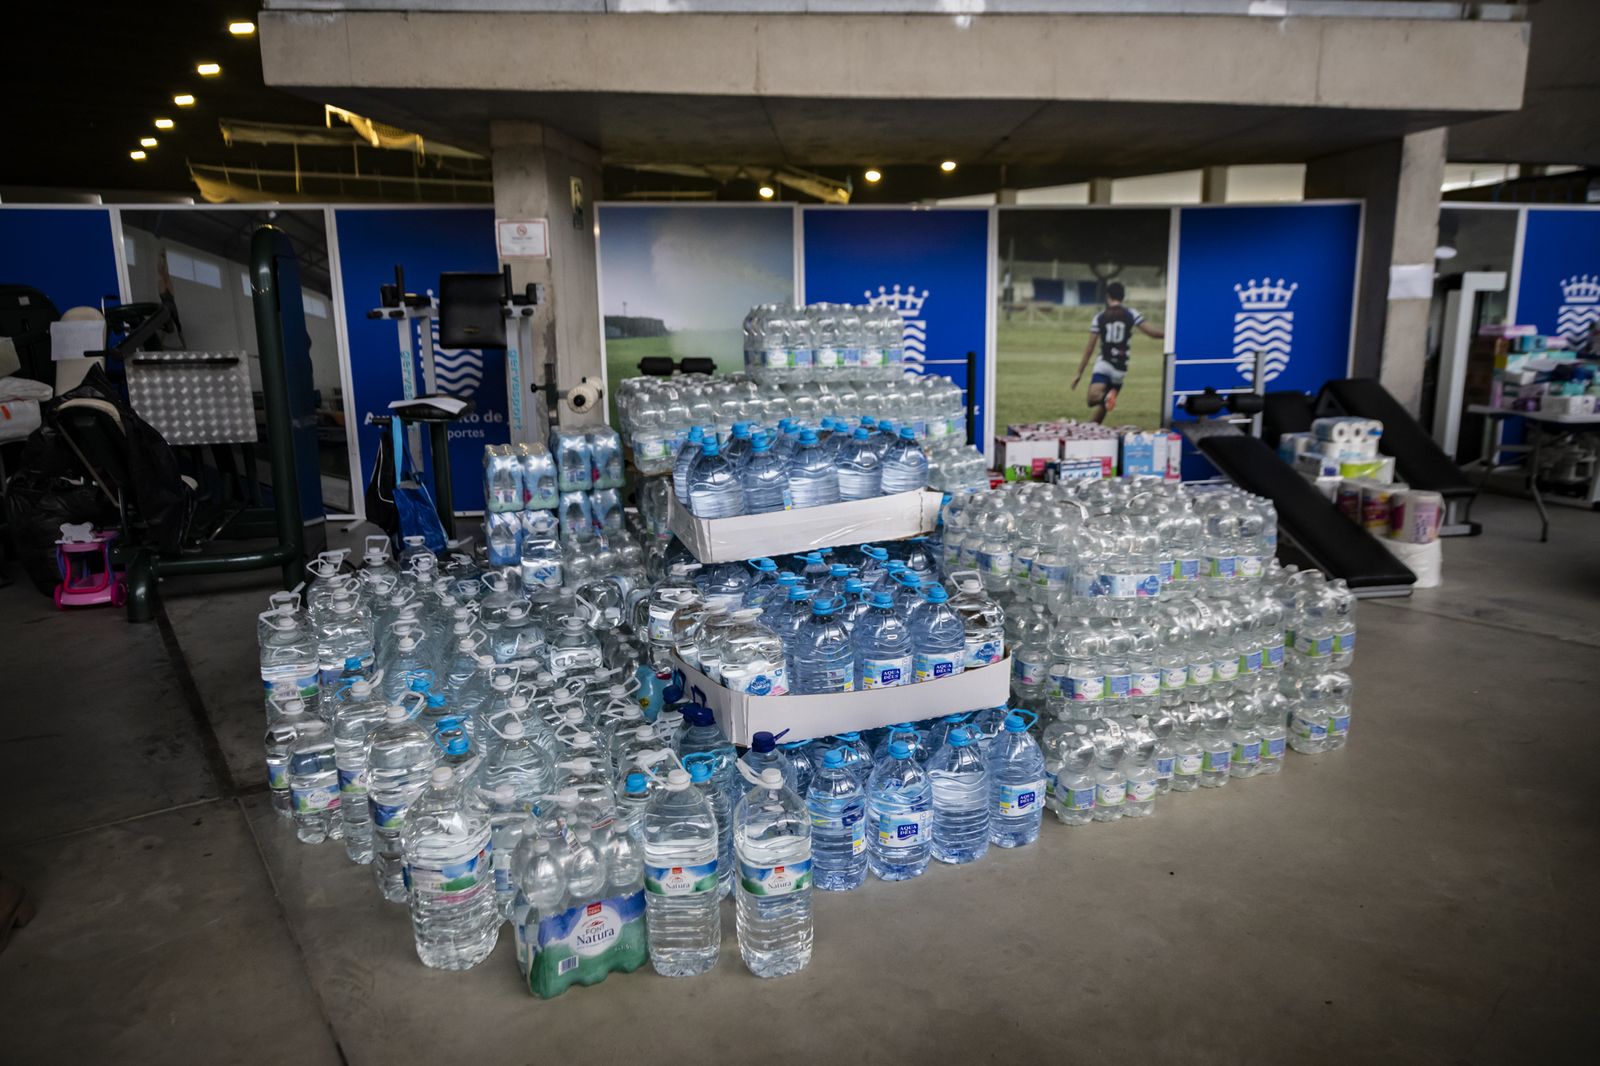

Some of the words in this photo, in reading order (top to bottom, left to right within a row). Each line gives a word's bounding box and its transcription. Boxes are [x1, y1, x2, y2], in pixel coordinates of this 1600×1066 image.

[1105, 321, 1125, 343] 10
[507, 349, 522, 431] gervasport
[483, 410, 503, 424] de
[449, 428, 485, 441] portes
[577, 928, 615, 946] Natura
[585, 923, 606, 936] FONT
